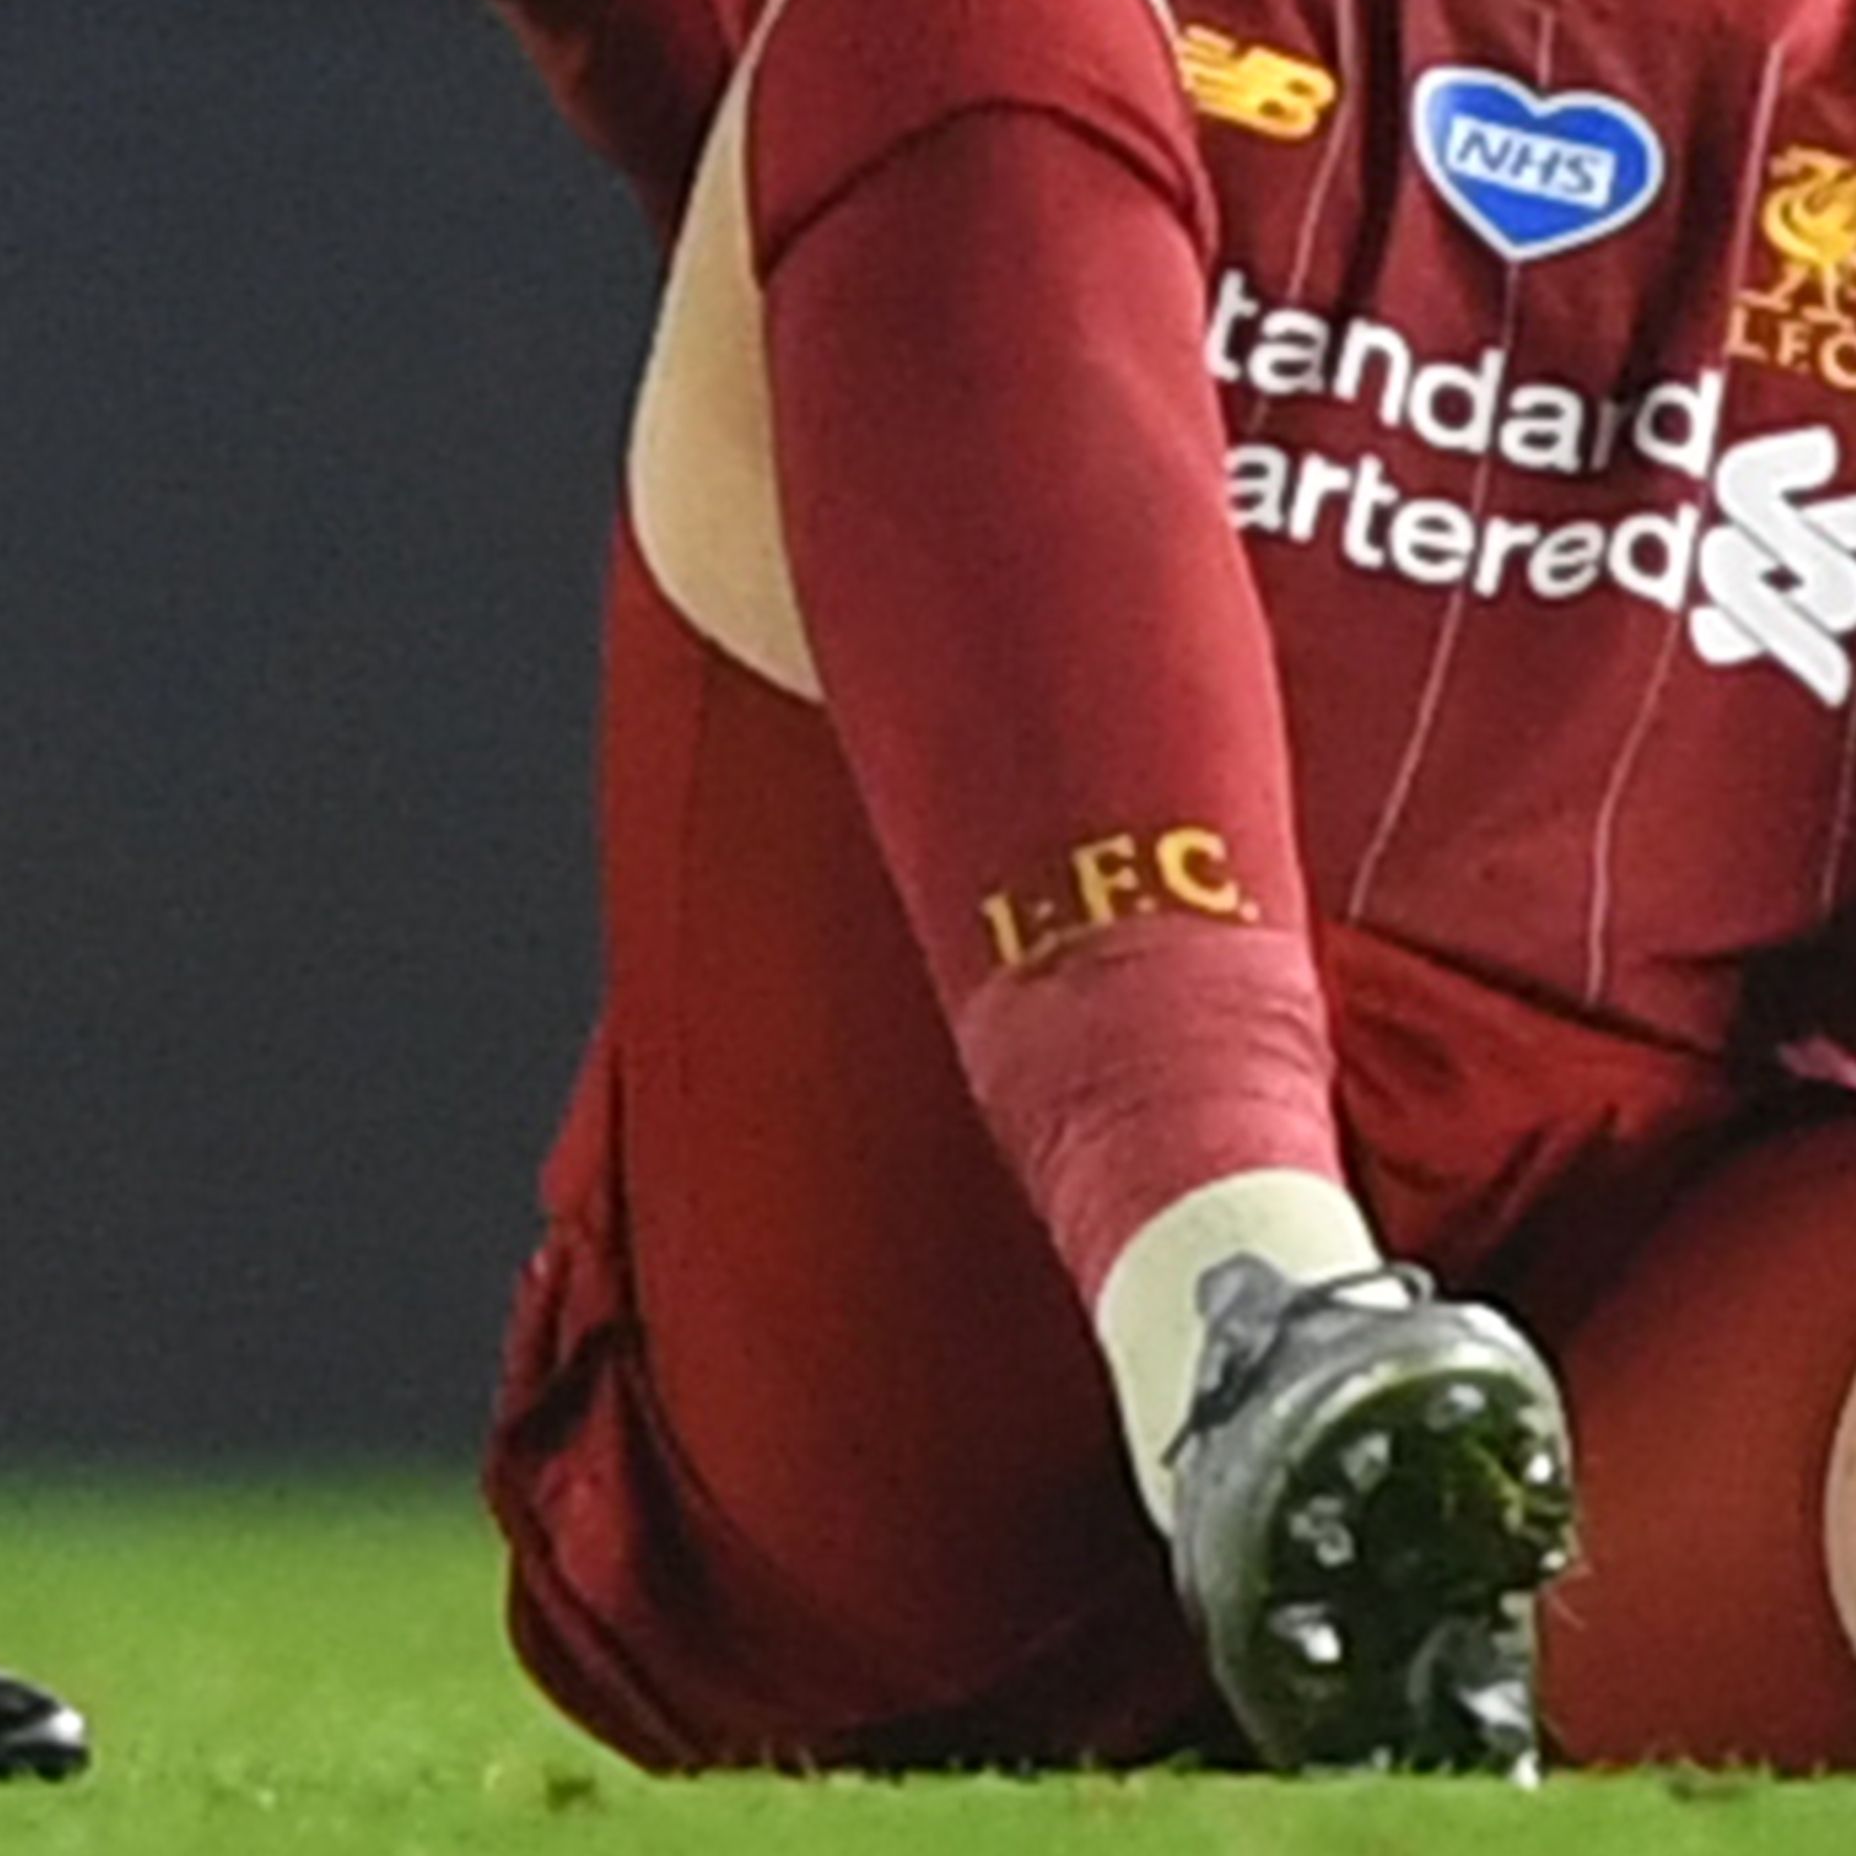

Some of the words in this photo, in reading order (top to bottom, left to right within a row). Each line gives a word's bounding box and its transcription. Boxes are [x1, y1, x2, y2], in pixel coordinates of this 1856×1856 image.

[1457, 130, 1596, 195] NHS
[1206, 270, 1723, 478] tandard
[1227, 443, 1699, 610] artered
